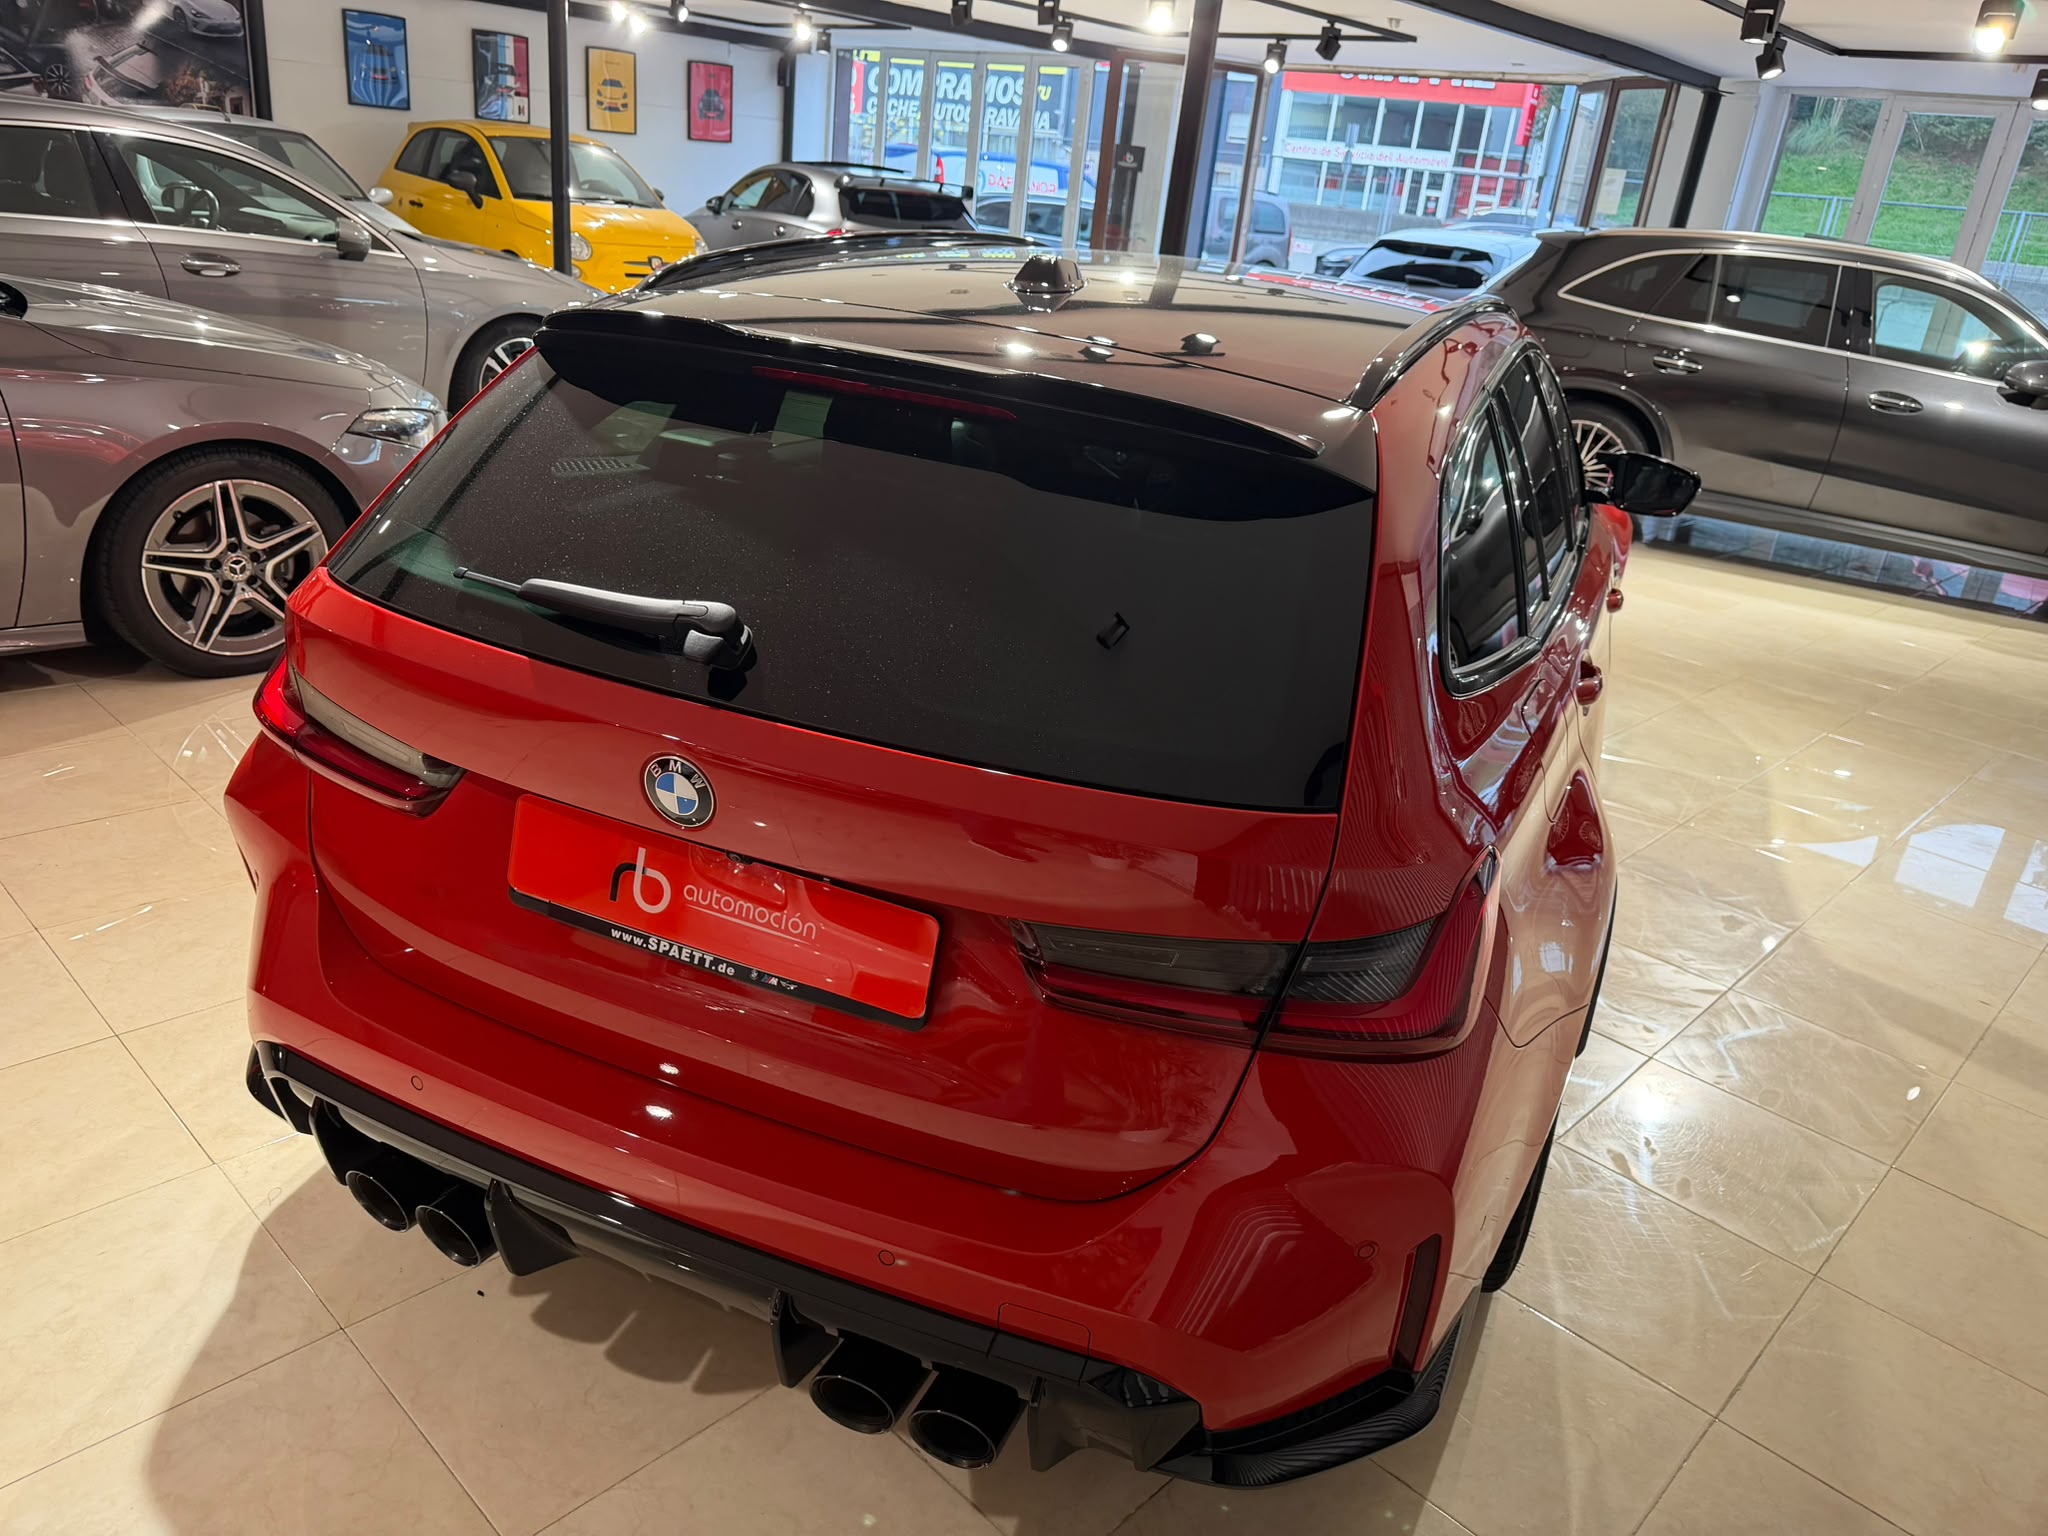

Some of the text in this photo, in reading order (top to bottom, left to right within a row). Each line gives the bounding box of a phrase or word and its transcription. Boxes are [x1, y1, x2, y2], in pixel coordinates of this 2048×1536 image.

[867, 66, 1025, 106] COMRAMOS
[866, 96, 921, 119] CCHE
[1336, 147, 1377, 161] Sevicio
[650, 759, 706, 789] BMW
[609, 847, 672, 914] rb
[683, 884, 817, 940] automoción
[610, 928, 736, 977] www.SPAETT.de
